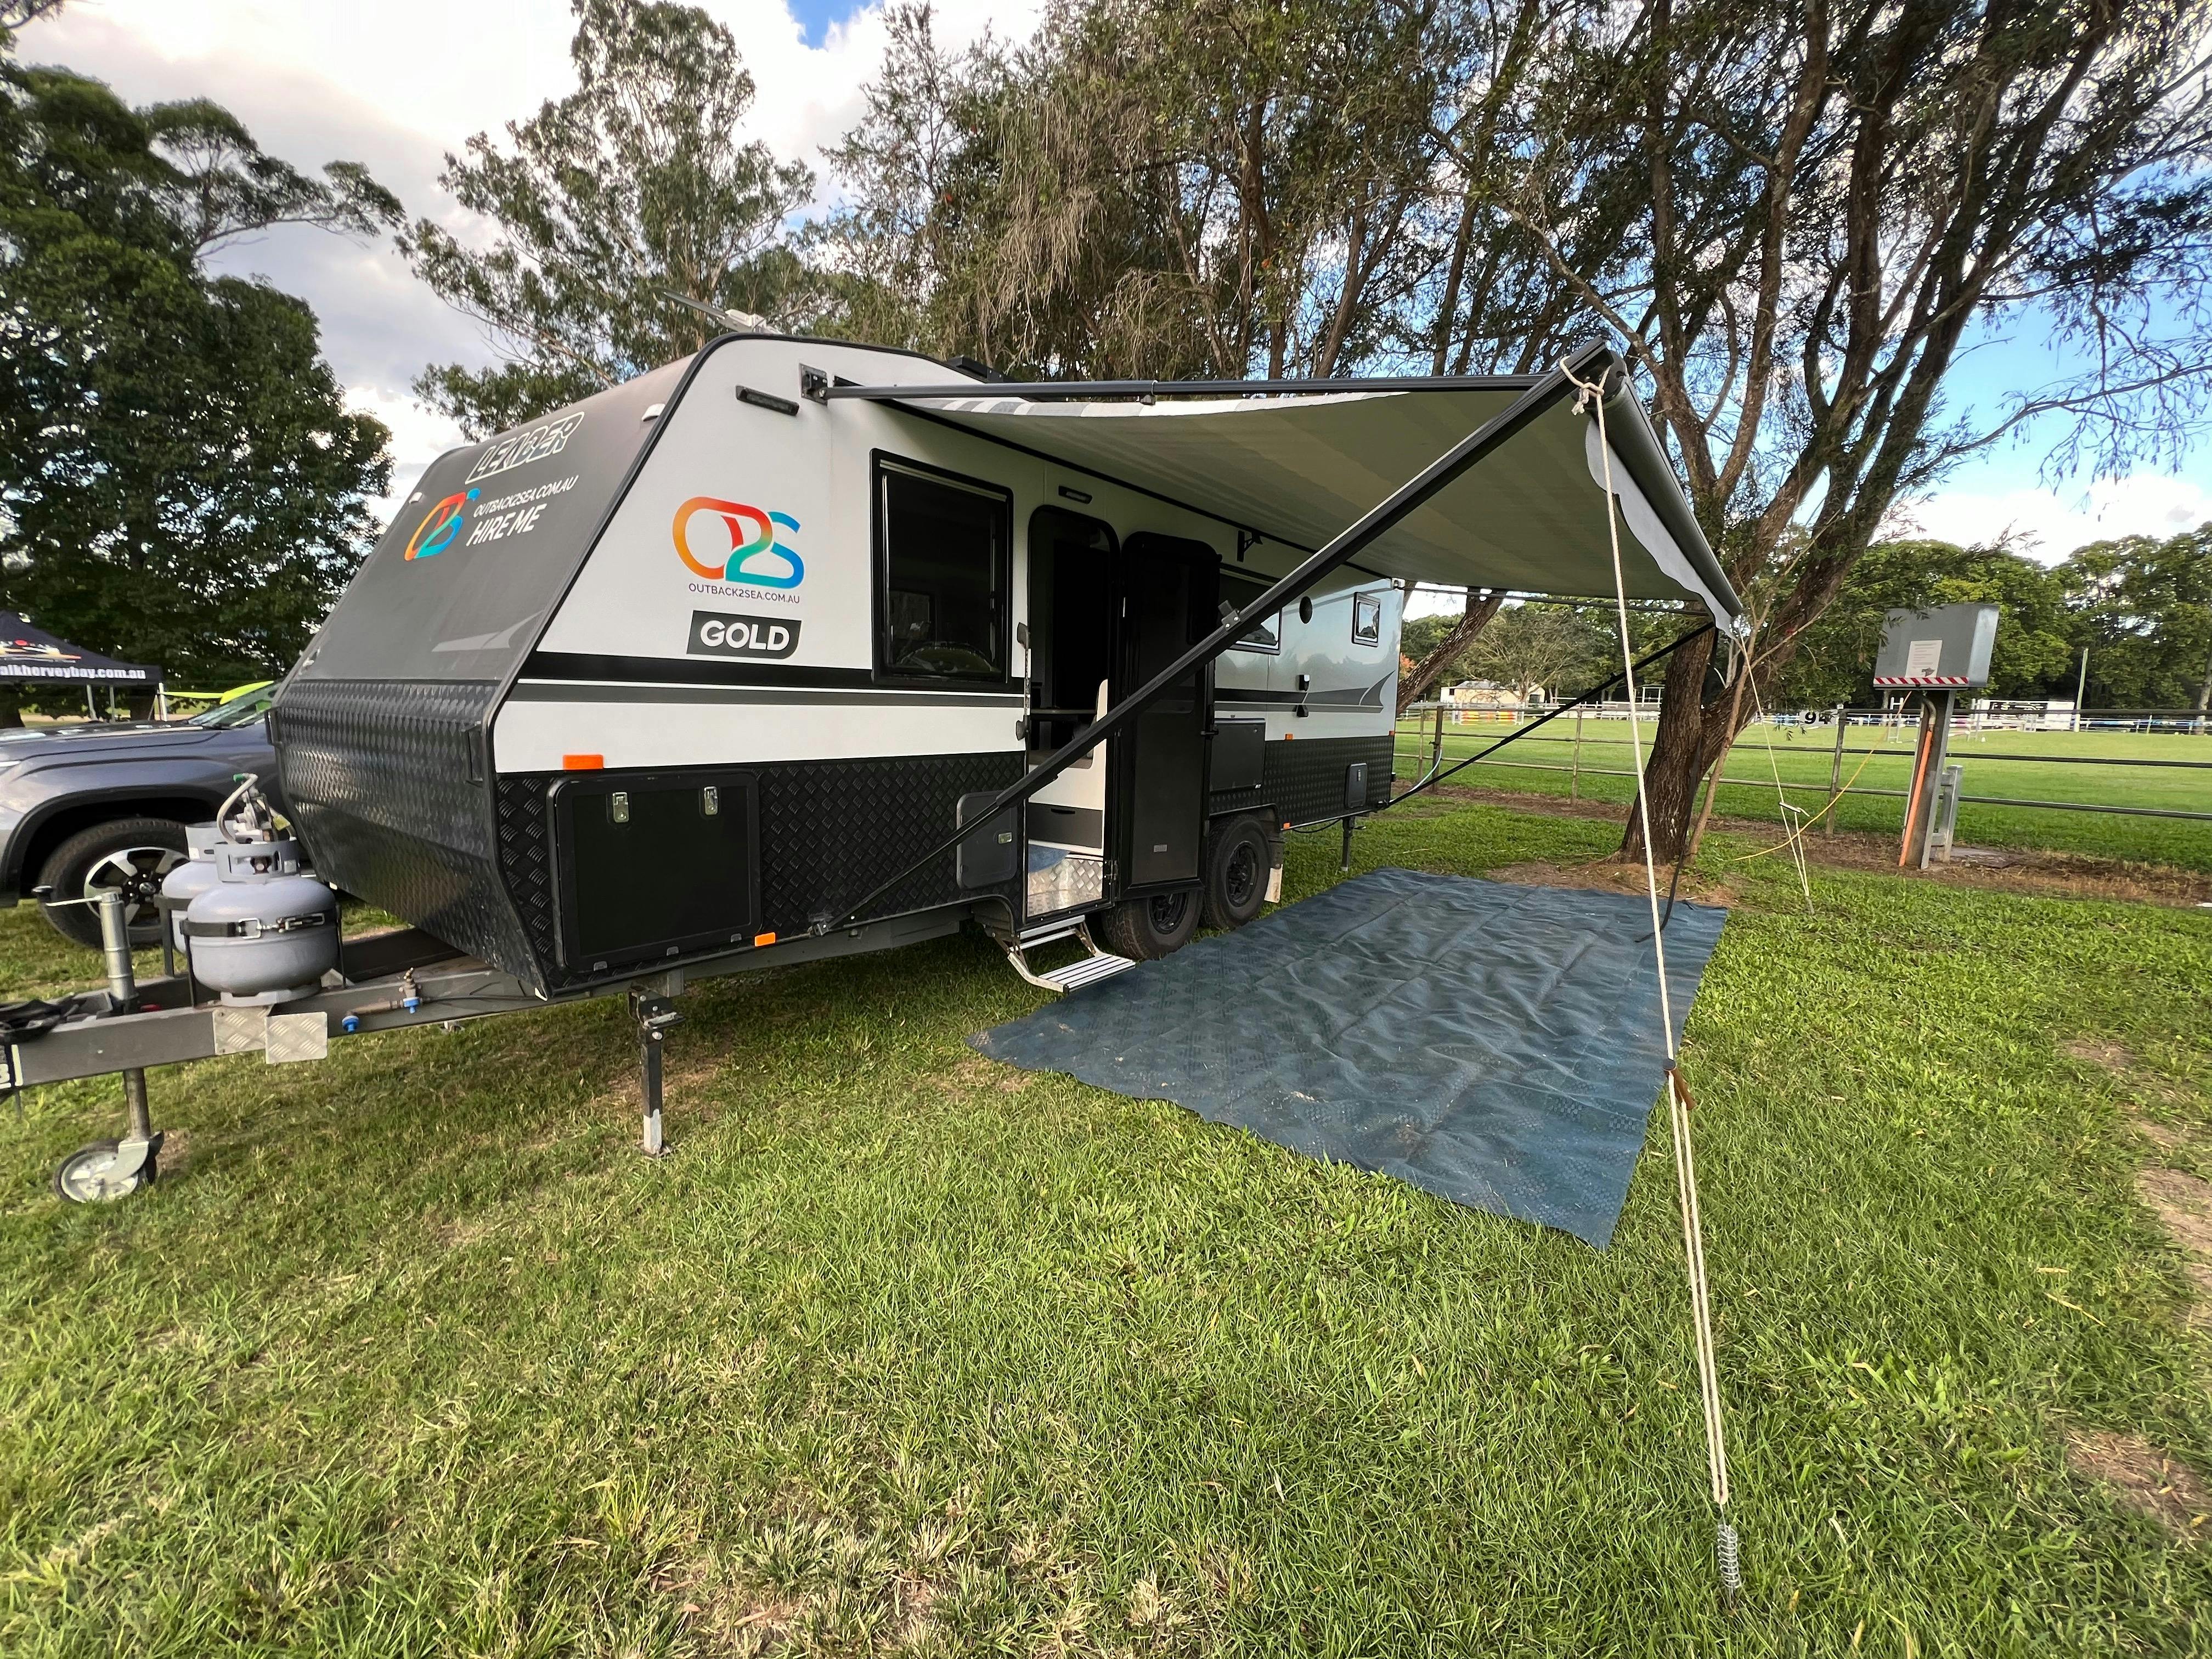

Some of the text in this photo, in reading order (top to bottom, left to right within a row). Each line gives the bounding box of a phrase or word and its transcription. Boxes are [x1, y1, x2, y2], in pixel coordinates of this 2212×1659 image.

[465, 412, 585, 484] LEADER
[473, 475, 579, 517] OUTBACK2SEA.COM.AU
[466, 504, 547, 546] HIRE ME
[689, 583, 800, 603] OUTBACK2SEA.COM.AU
[700, 620, 790, 651] GOLD
